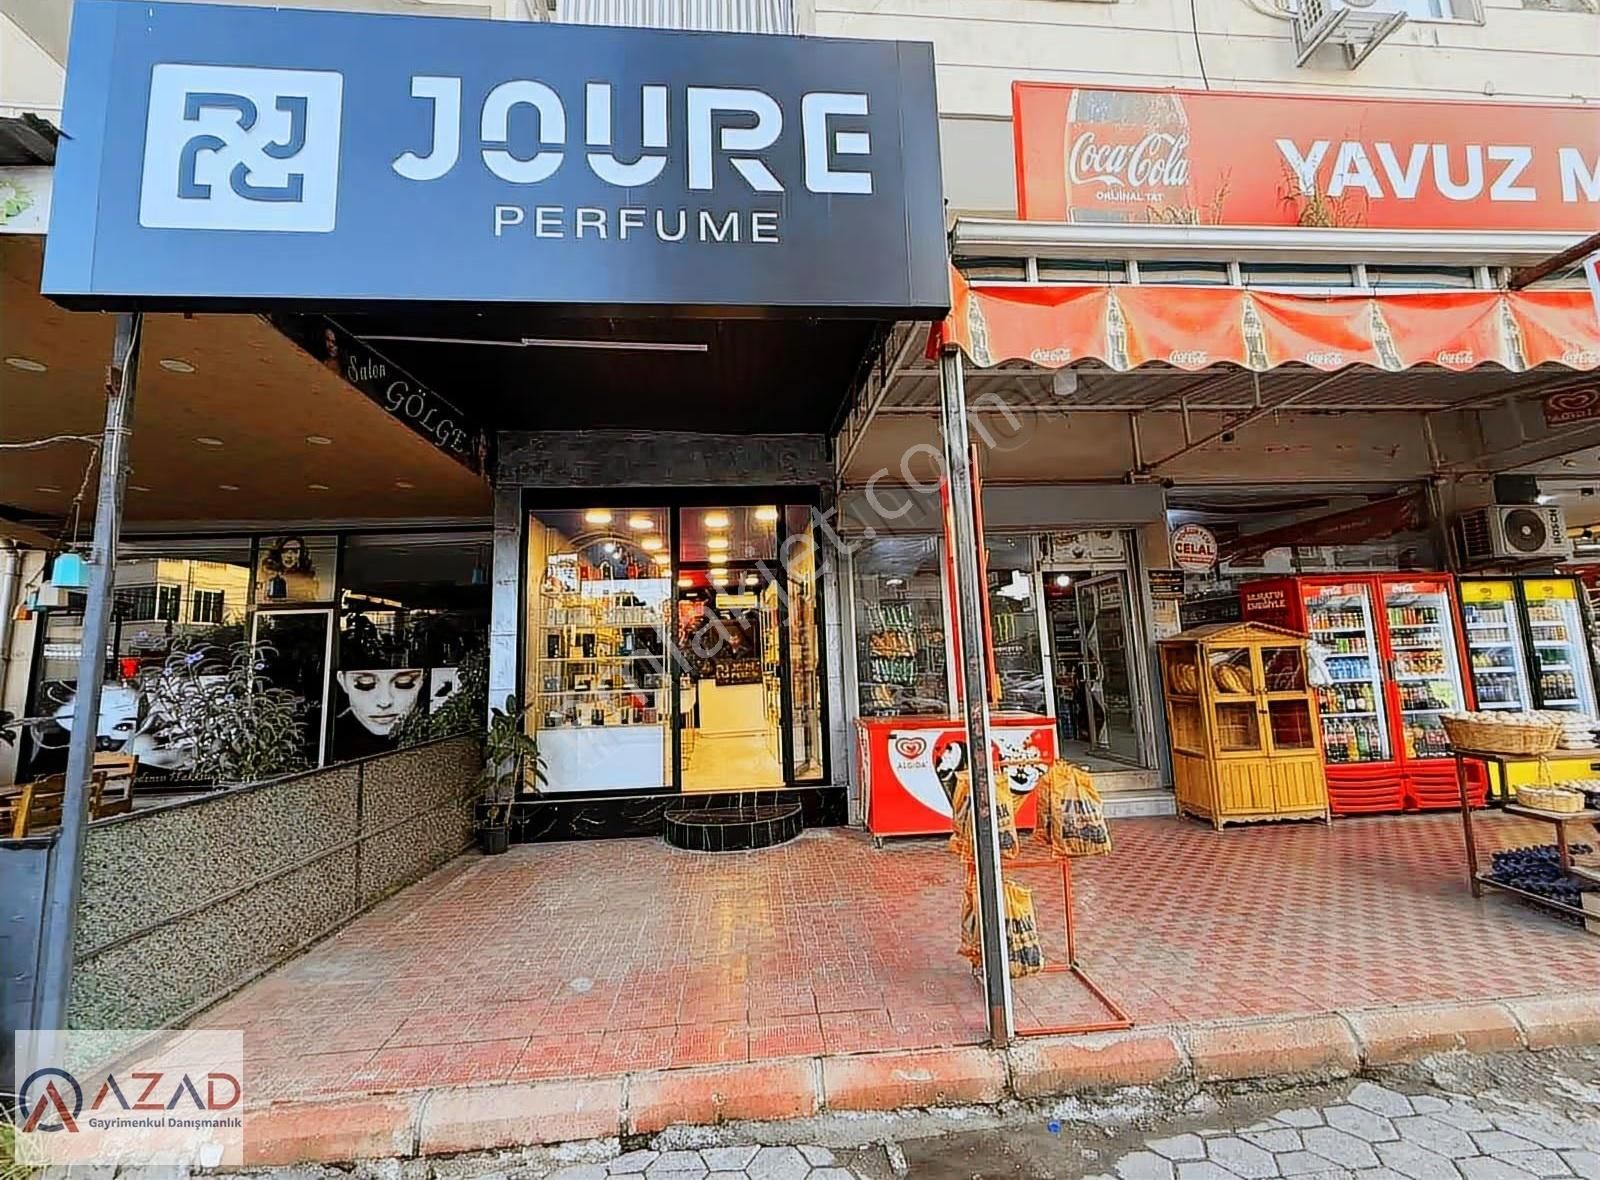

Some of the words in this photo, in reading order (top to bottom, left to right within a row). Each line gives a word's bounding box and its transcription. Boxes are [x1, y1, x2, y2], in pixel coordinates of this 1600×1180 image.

[391, 75, 873, 194] JOURE
[1275, 139, 1537, 202] YAVUZ
[494, 206, 780, 243] PERFUME
[347, 355, 386, 382] Salon
[384, 381, 467, 453] GÖLGE
[1175, 542, 1214, 557] CELAL
